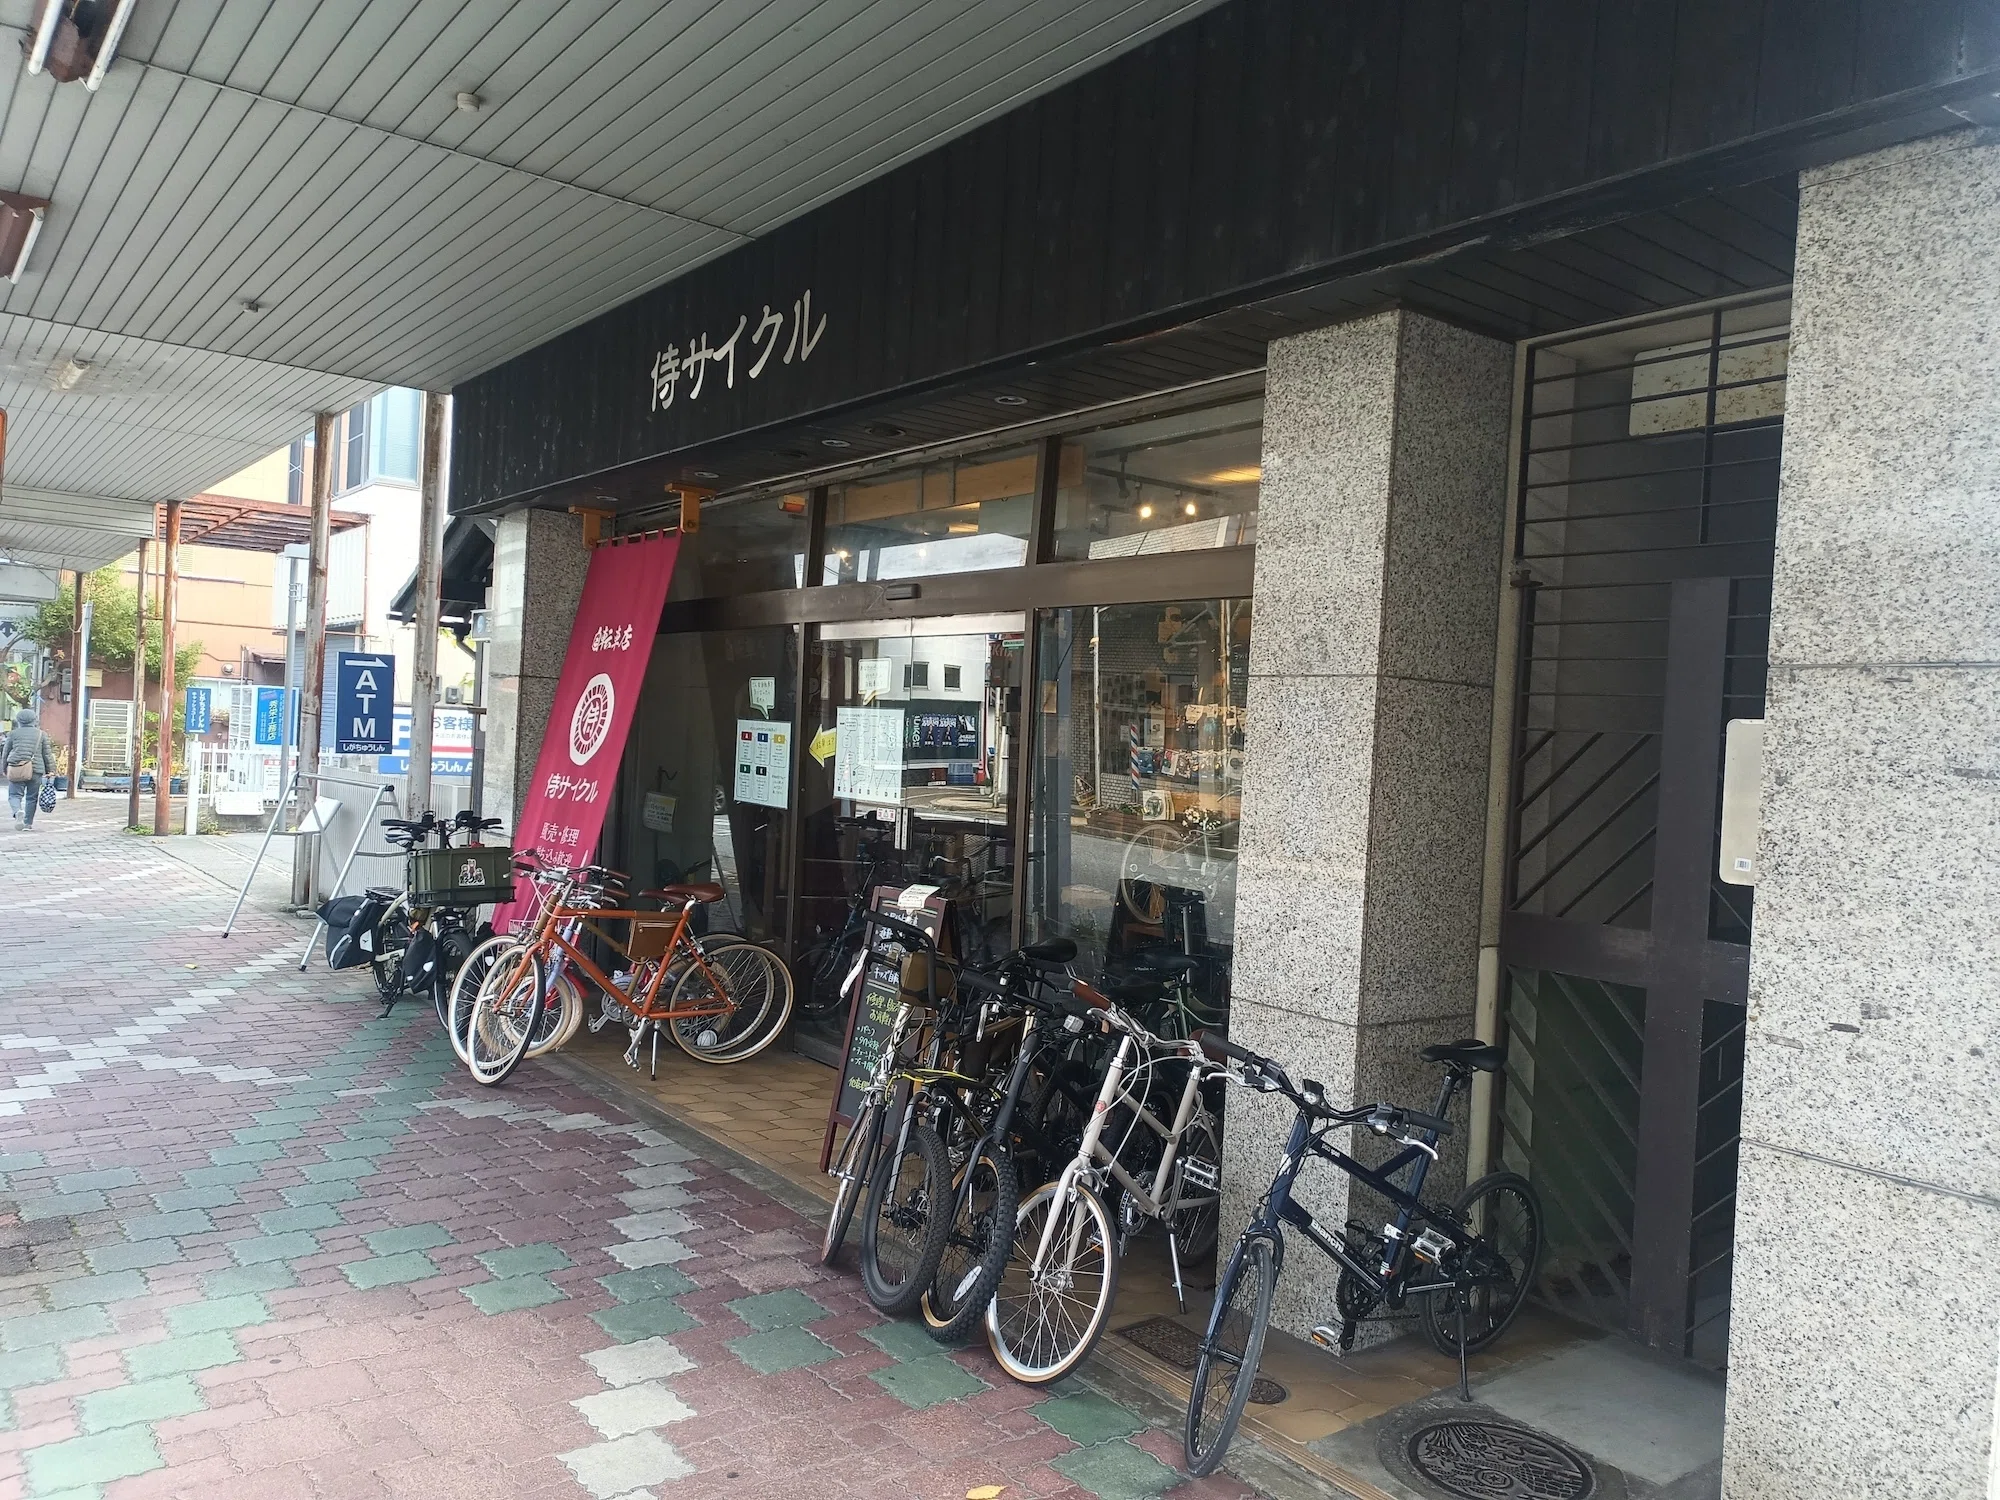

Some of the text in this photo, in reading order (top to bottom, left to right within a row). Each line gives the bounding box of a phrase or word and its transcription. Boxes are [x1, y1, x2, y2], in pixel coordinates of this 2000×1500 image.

[651, 289, 827, 412] 侍サイクル
[592, 624, 632, 651] 自転車店
[353, 670, 378, 738] ATM
[343, 744, 385, 752] しがちゅうしん
[544, 772, 598, 803] 侍サイクル
[540, 822, 580, 846] 販売・修理
[1311, 1219, 1345, 1253] Bianchi
